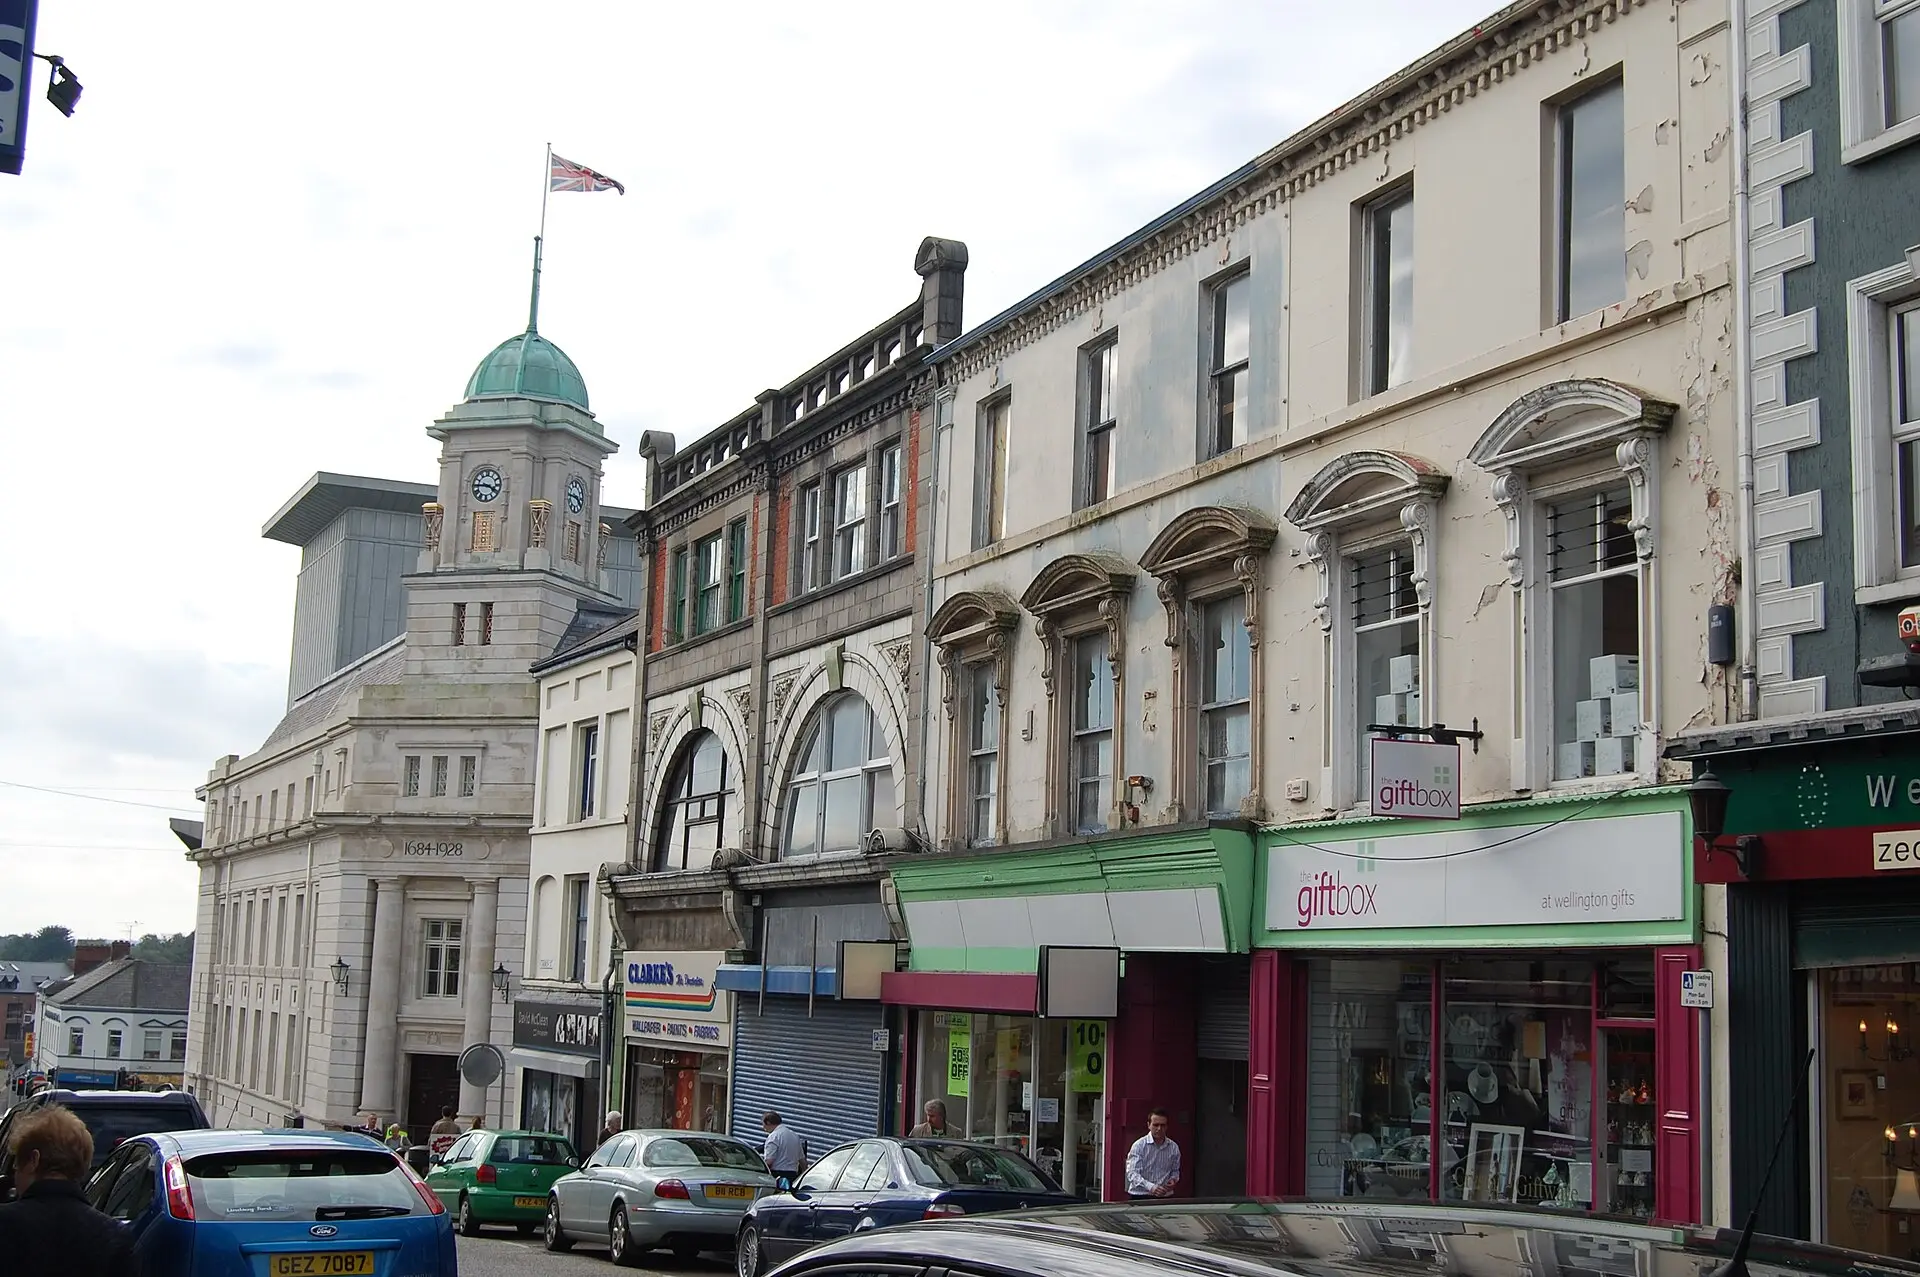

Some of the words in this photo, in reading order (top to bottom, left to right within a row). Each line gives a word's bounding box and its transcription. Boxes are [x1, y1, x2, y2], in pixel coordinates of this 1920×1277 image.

[1380, 780, 1452, 810] giftbox
[404, 840, 463, 858] 1684-1928
[1300, 869, 1311, 882] the
[1298, 869, 1378, 927] giftbox
[1541, 894, 1552, 909] at
[1554, 891, 1608, 911] wellington
[1611, 888, 1635, 910] gifts
[628, 962, 674, 986] CLARKE'S
[279, 1257, 314, 1274] GEZ
[321, 1255, 366, 1273] 7087
